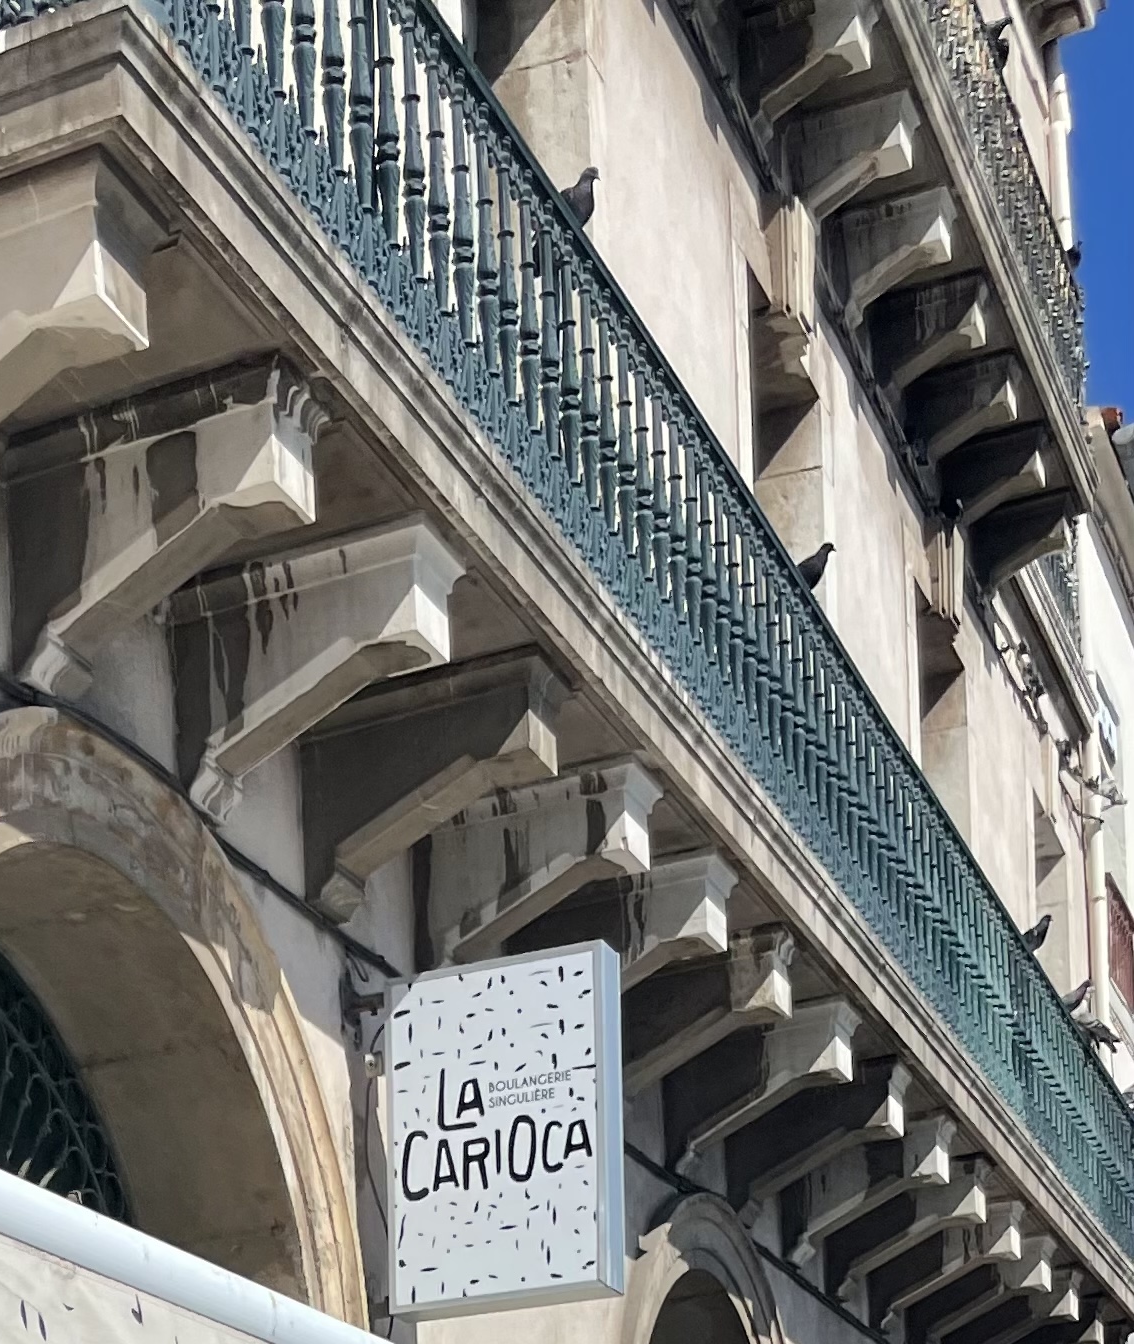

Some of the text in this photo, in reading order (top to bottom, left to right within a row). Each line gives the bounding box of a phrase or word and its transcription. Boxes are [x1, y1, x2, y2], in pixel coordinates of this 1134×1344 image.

[437, 1067, 486, 1131] LA
[488, 1069, 572, 1093] BOULANGERIE
[488, 1086, 556, 1109] SINGULIÈRE
[401, 1113, 593, 1202] CARIOCA
